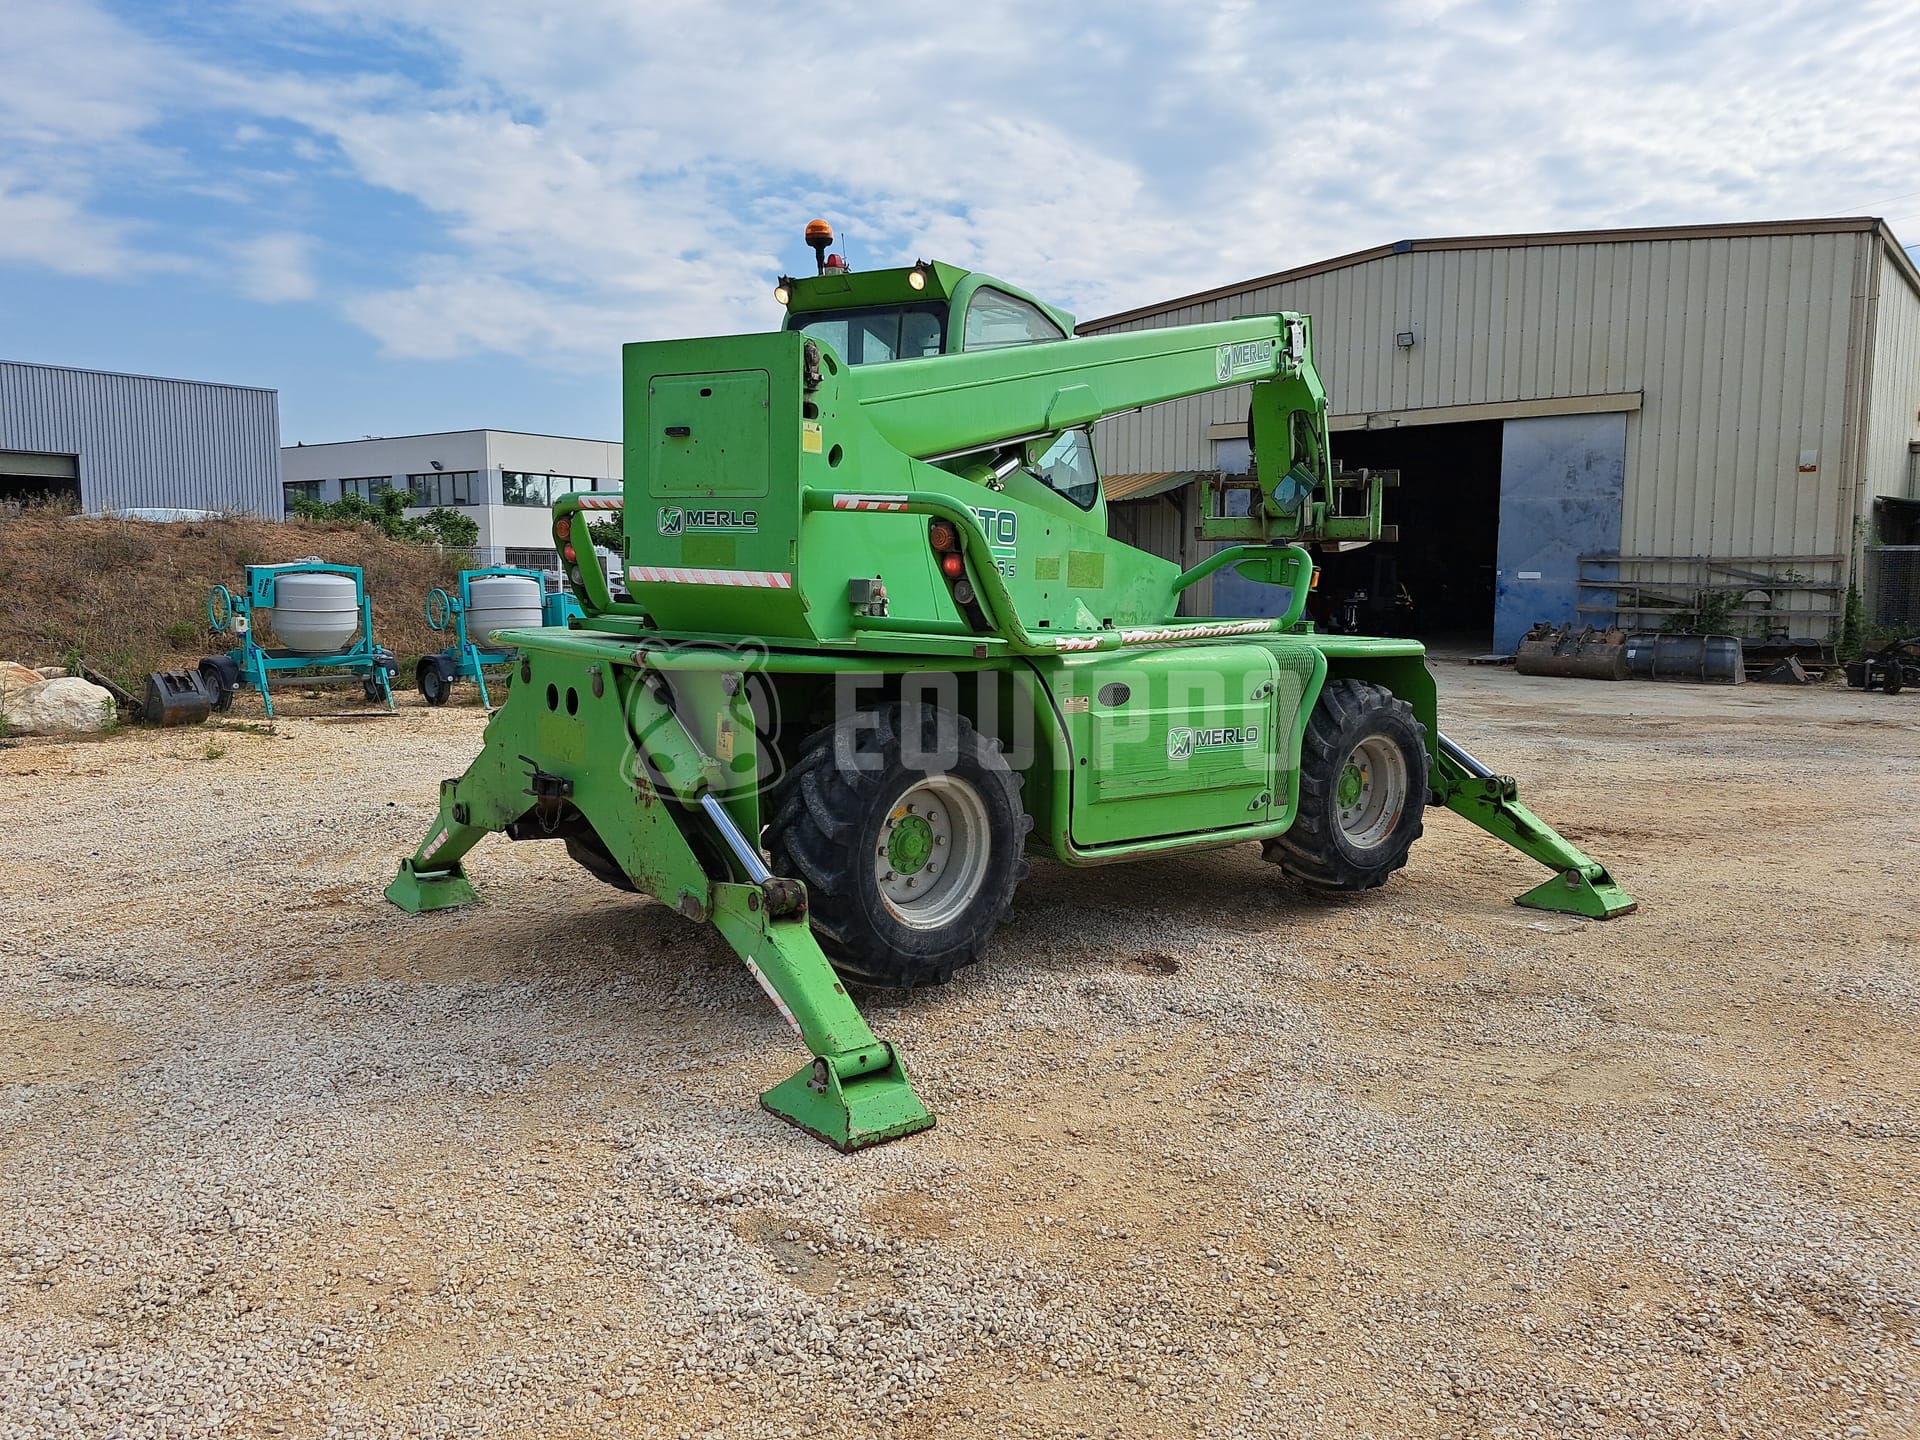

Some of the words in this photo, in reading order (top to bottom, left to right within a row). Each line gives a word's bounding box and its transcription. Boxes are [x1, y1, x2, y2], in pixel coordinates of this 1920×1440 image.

[1233, 340, 1272, 366] MERLO
[686, 510, 758, 527] MERLO
[967, 506, 1017, 545] TO
[1195, 726, 1258, 746] MERLO
